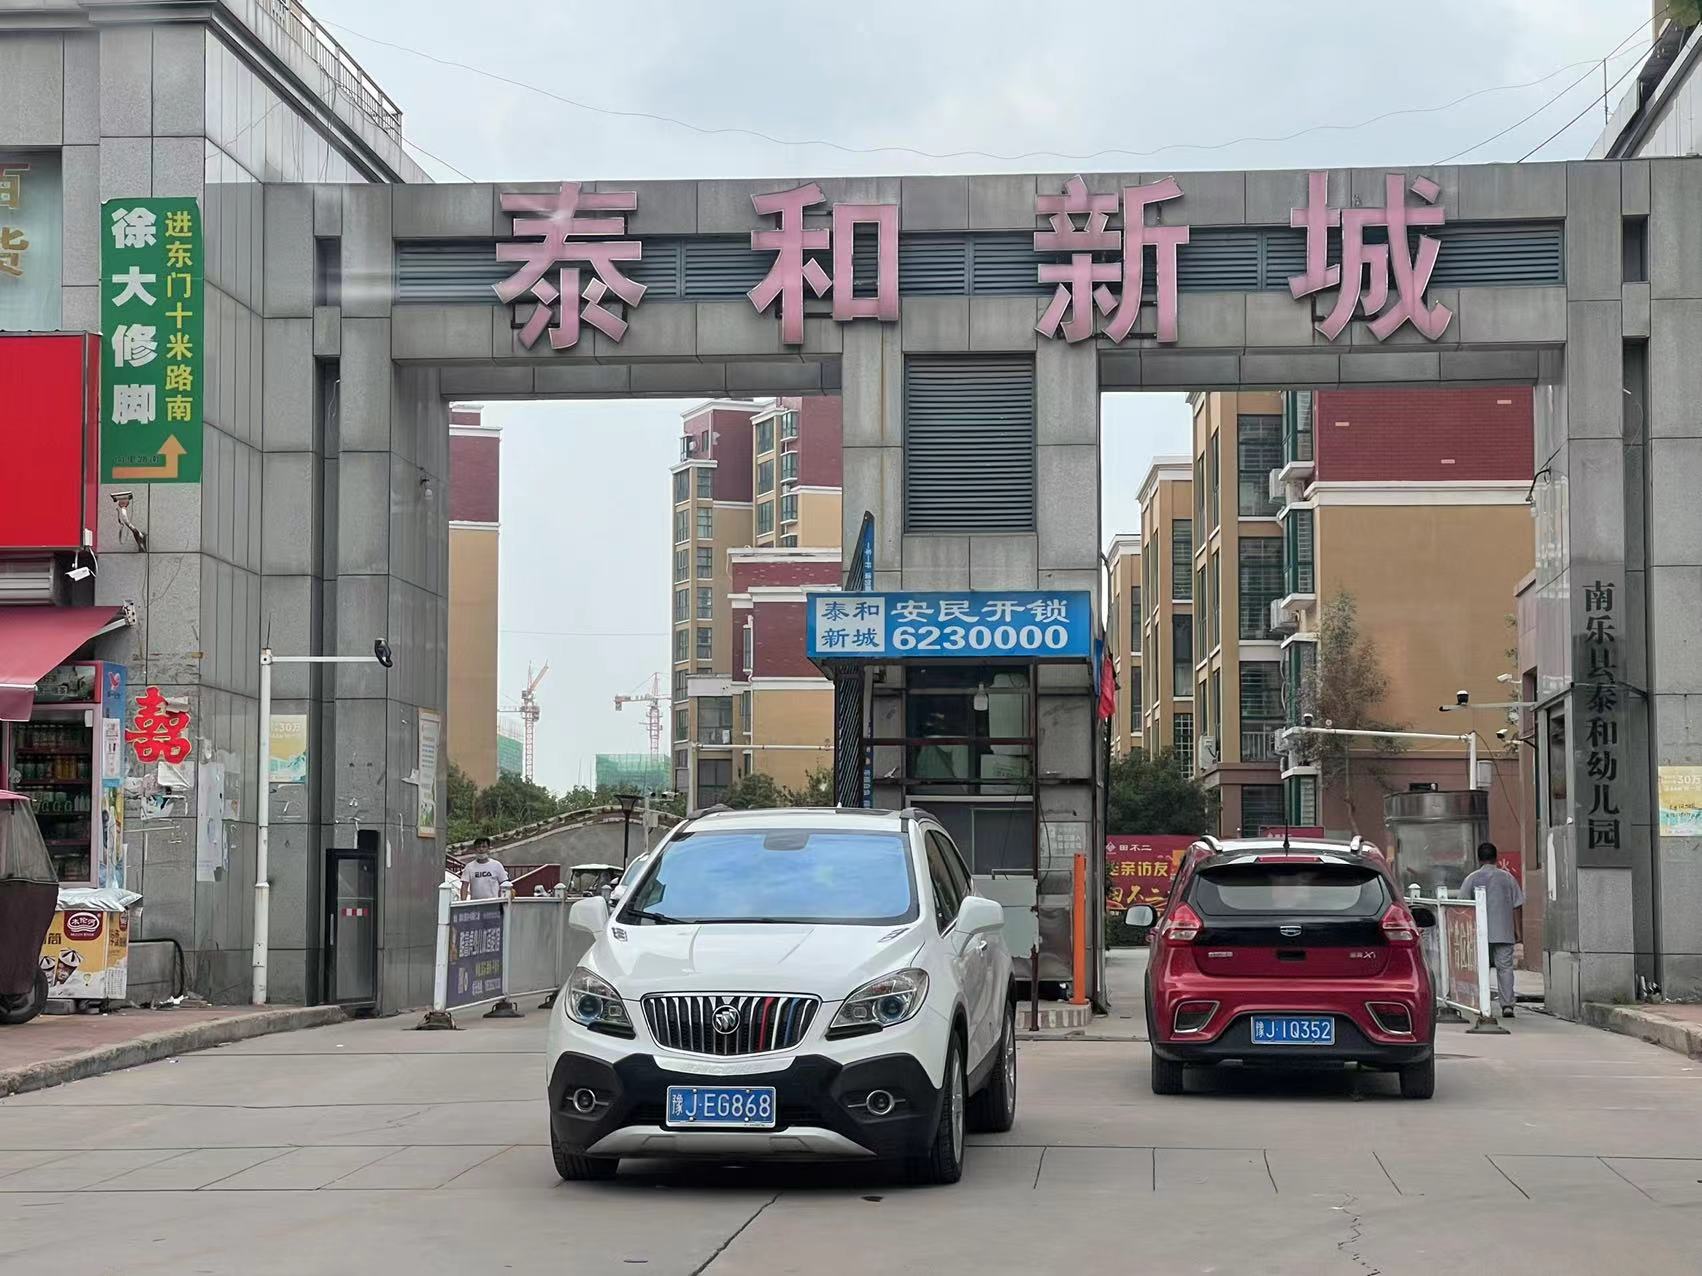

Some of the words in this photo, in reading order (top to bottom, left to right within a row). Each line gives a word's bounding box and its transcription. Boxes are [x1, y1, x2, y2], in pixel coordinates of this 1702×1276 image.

[492, 170, 1453, 350] 泰和新城
[165, 211, 193, 421] 进东门十米路南
[821, 601, 880, 621] 泰和
[890, 599, 1070, 623] 安民开锁
[821, 628, 880, 648] 新城
[892, 625, 1069, 650] 6230000
[1582, 580, 1620, 849] 南乐县泰和幼儿园
[1119, 844, 1153, 852] 田不二
